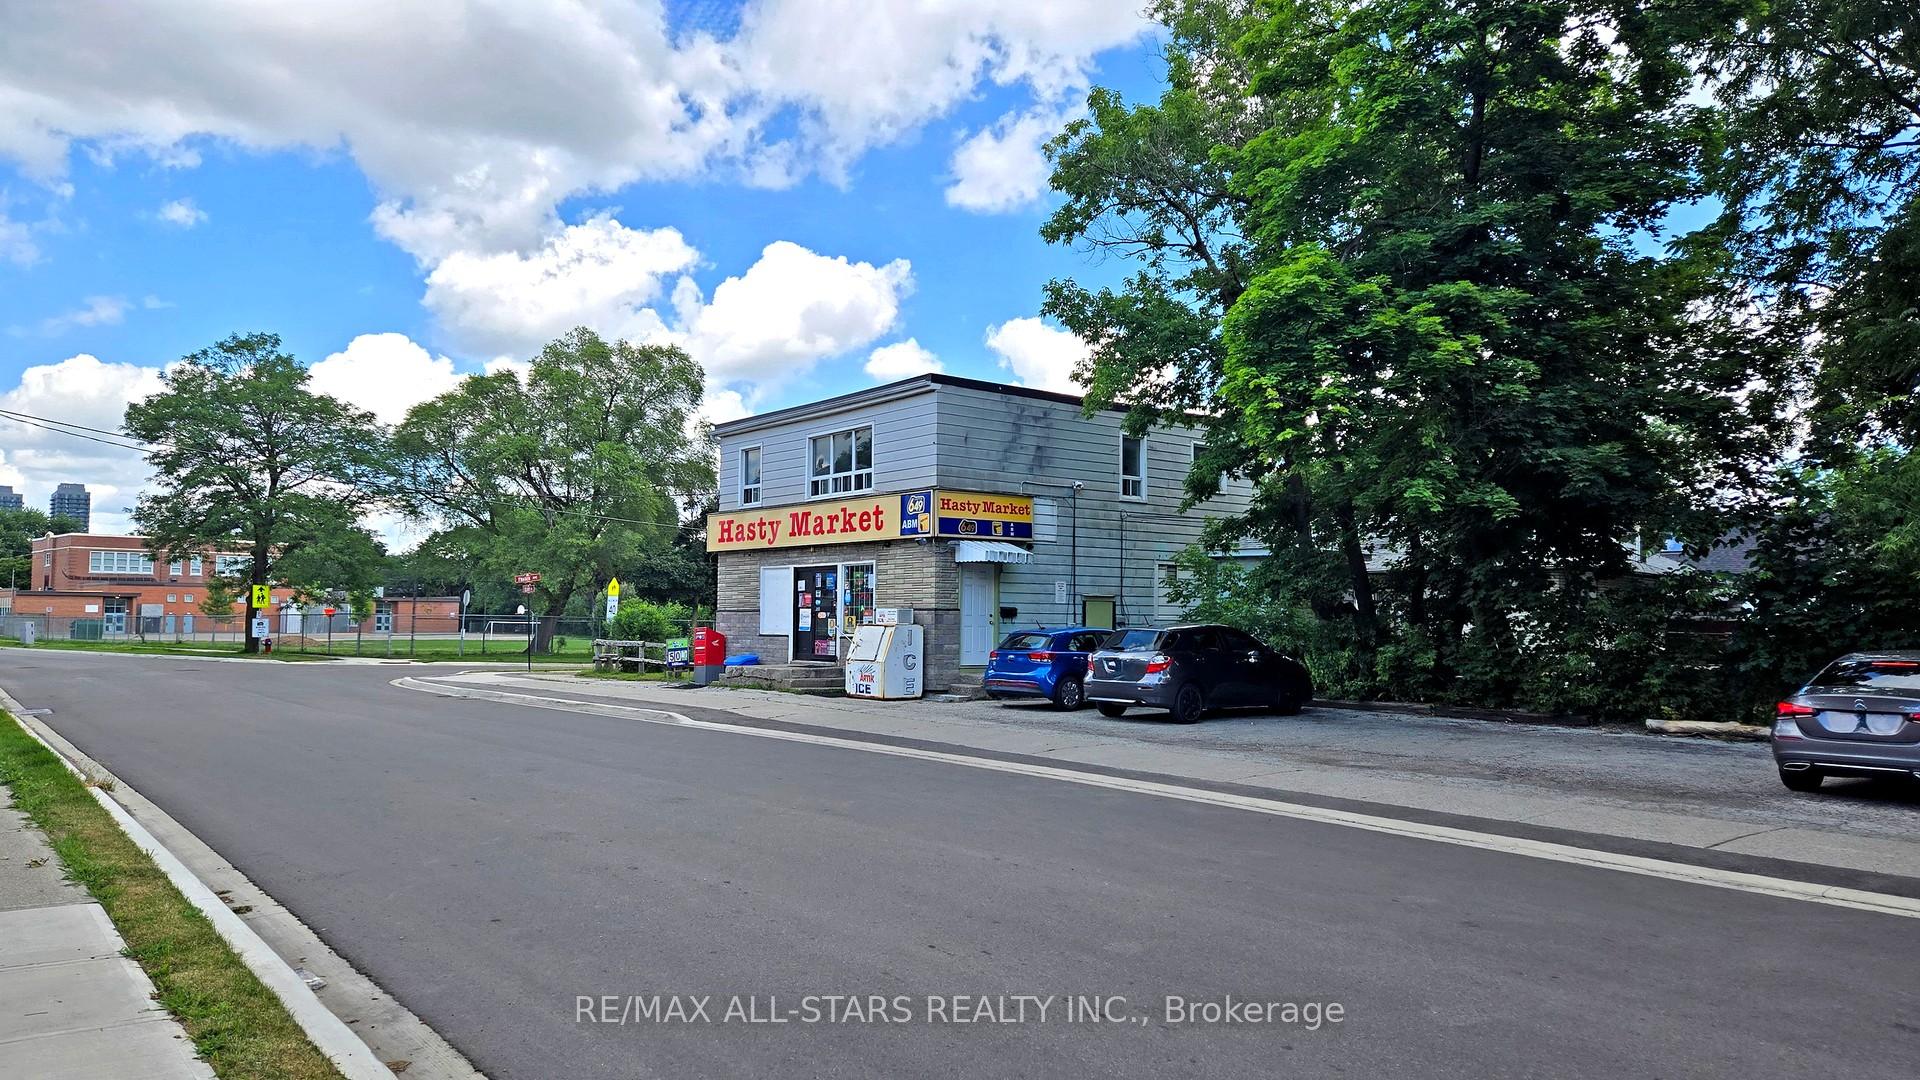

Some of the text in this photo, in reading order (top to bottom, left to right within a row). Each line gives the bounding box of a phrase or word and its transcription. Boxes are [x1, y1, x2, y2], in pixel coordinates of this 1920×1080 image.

[908, 498, 923, 512] 649
[940, 498, 1031, 516] Hasty Market
[718, 505, 884, 545] Hasty Market
[902, 519, 917, 529] ABM
[960, 521, 976, 532] 649
[903, 630, 916, 695] ICE
[855, 683, 871, 694] ICE
